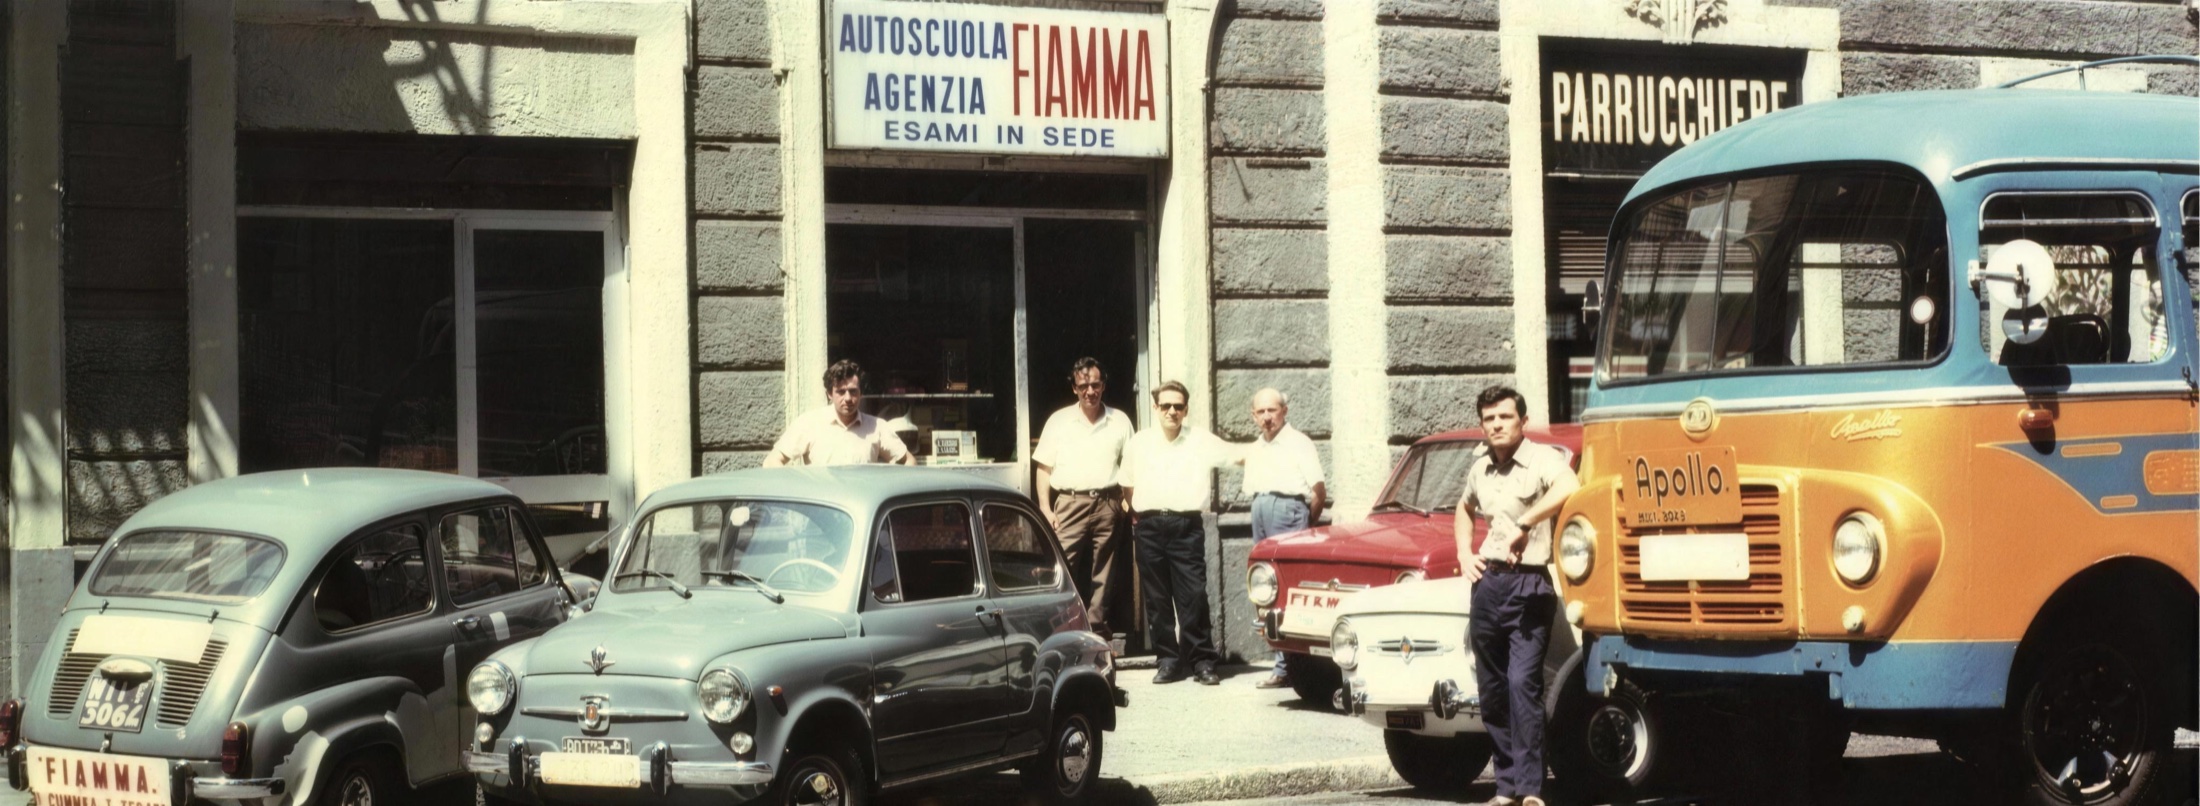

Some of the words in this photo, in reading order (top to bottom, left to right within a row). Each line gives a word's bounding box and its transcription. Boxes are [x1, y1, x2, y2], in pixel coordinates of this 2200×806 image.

[839, 13, 1008, 60] AUTOSCUOLA
[864, 72, 986, 115] AGENZIA
[1012, 23, 1156, 121] FIAMMA
[884, 120, 978, 143] ESAMI
[997, 125, 1024, 145] IN
[1043, 126, 1115, 148] SEDE
